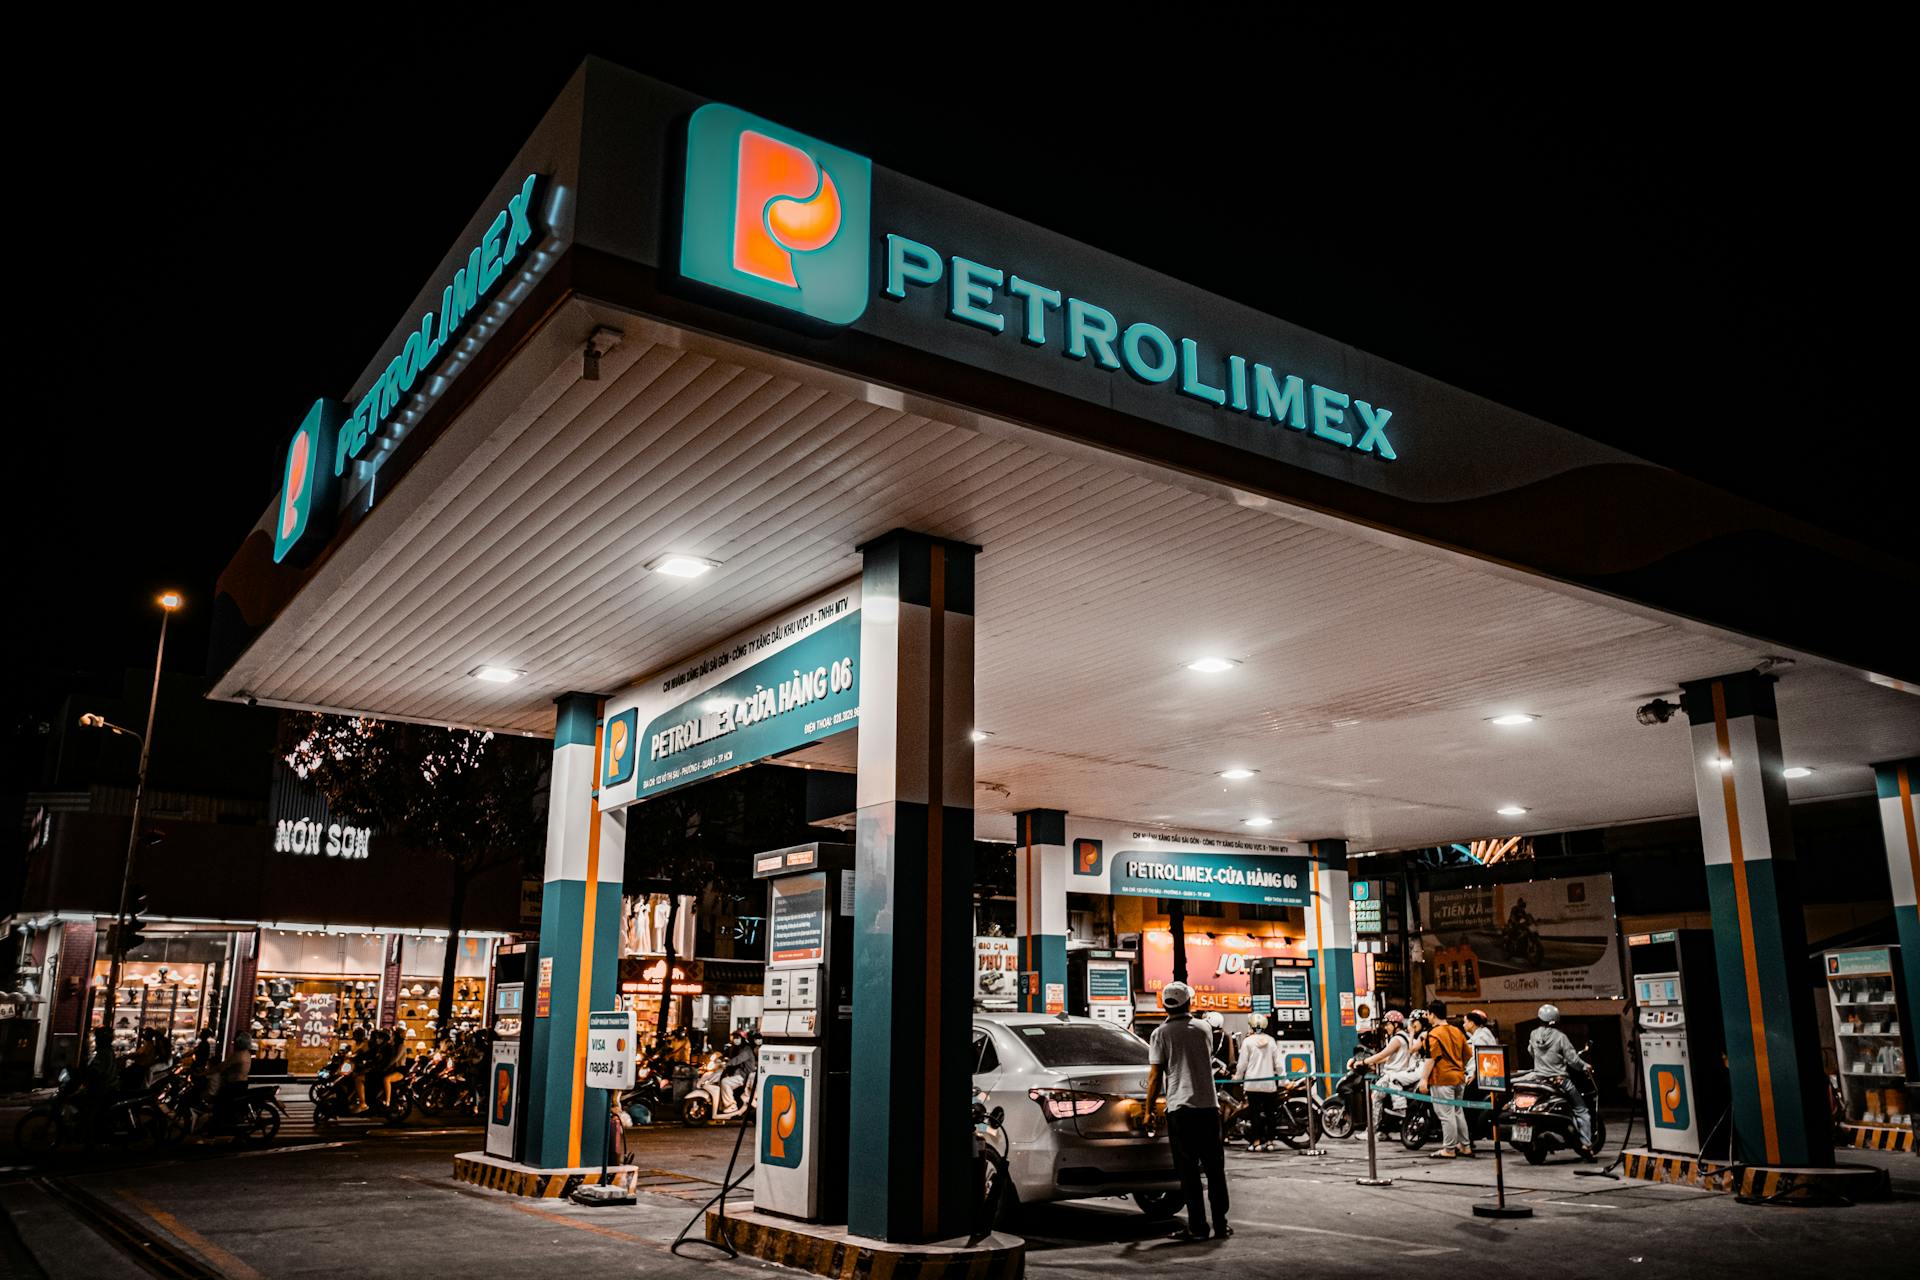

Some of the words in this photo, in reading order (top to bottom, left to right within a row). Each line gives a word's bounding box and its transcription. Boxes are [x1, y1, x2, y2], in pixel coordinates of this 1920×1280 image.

[335, 173, 536, 477] PETROLIMEX
[885, 232, 1397, 461] PETROLIMEX
[784, 622, 796, 638] KHU
[819, 604, 834, 622] TNHH
[835, 597, 848, 614] MTV
[778, 670, 828, 714] HÀNG
[830, 657, 853, 695] 06
[1246, 868, 1282, 888] HÀNG
[1283, 874, 1297, 889] 06
[1202, 995, 1228, 1007] SALE
[592, 1038, 606, 1051] VISA
[589, 1062, 608, 1077] napas
